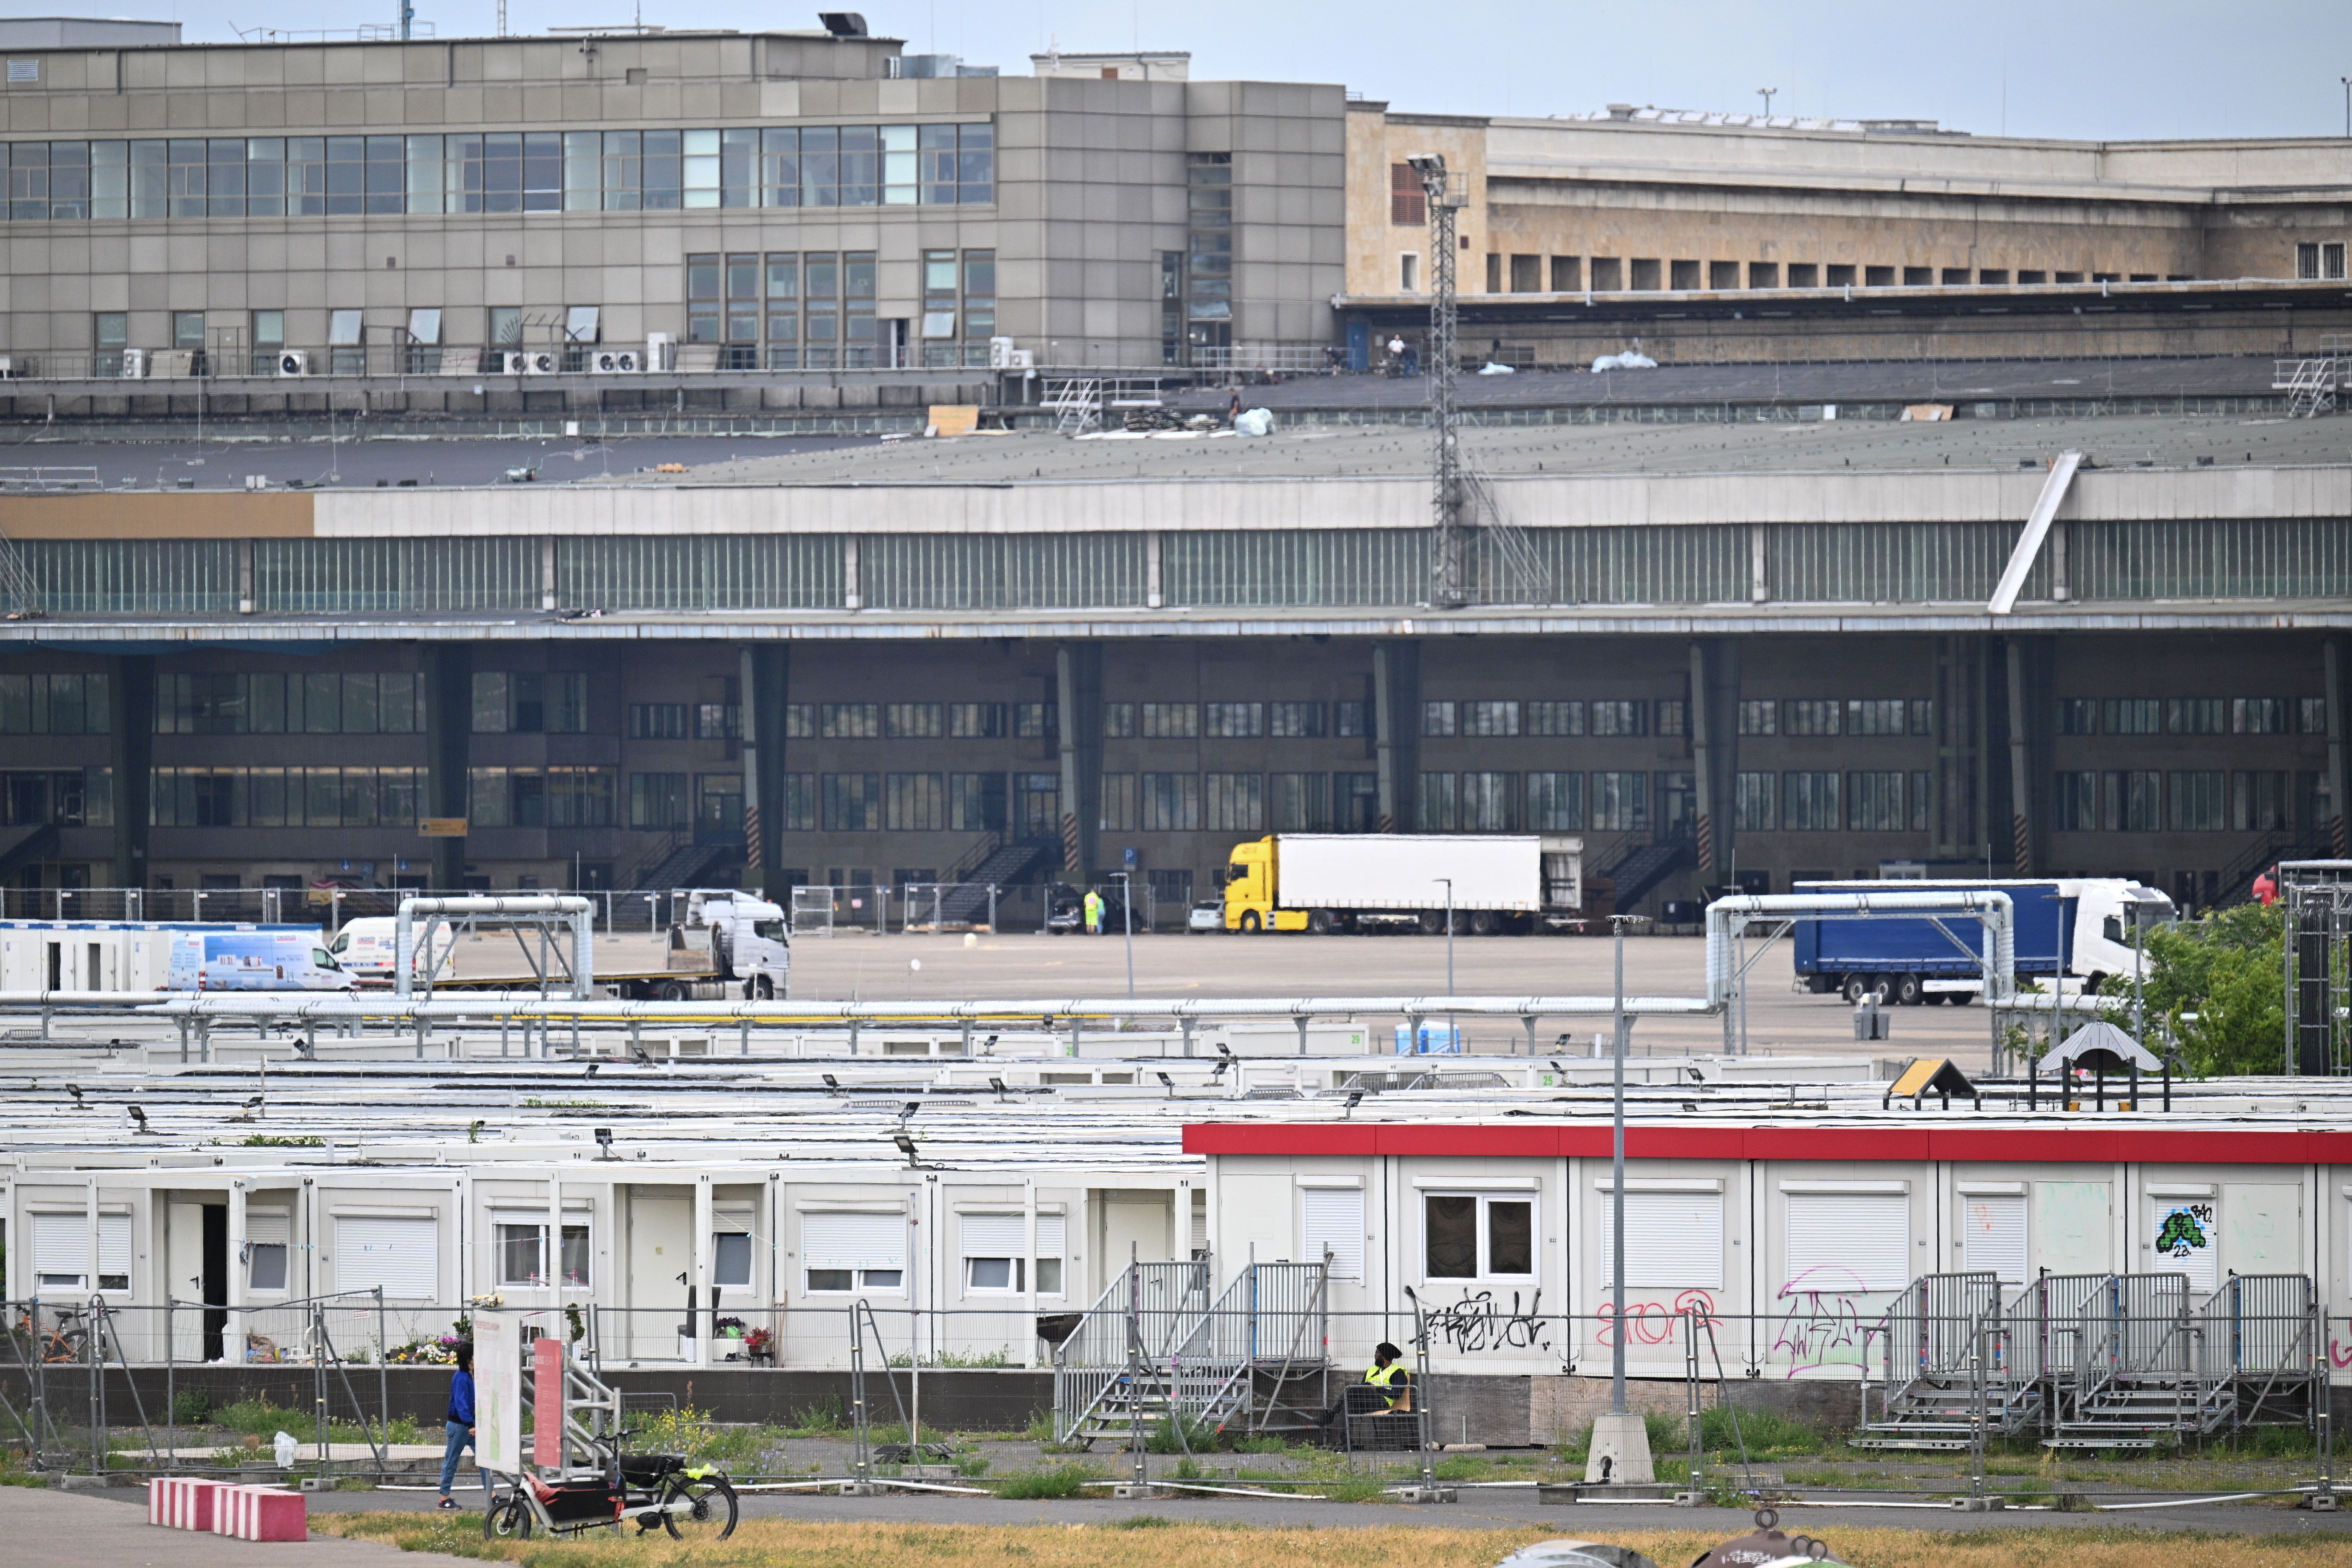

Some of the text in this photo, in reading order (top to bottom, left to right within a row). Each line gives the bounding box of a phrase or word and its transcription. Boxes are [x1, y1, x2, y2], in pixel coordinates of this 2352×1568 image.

[1125, 850, 1133, 861] P
[1352, 1035, 1360, 1044] 29
[1544, 1076, 1553, 1086] 25
